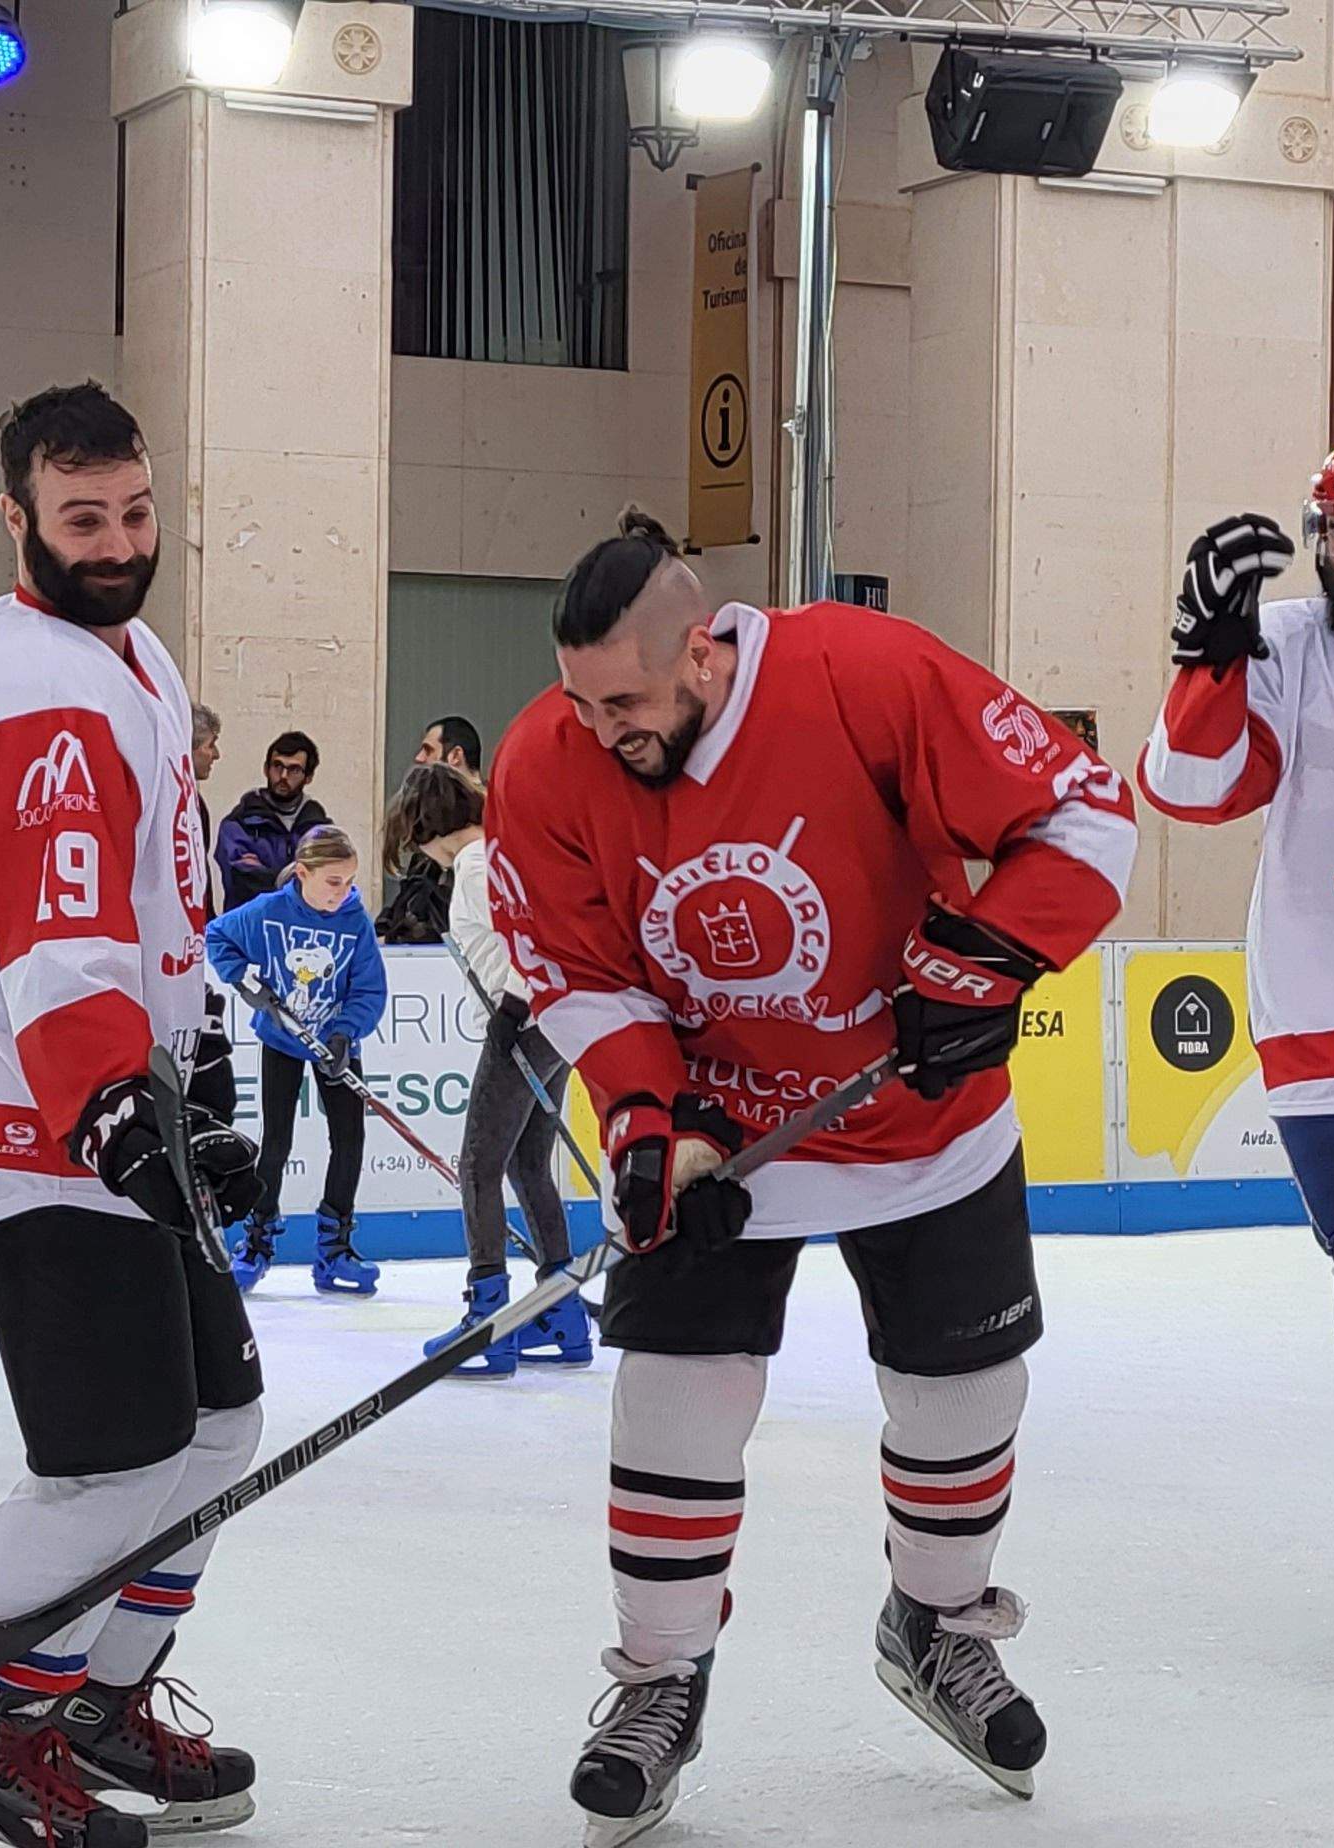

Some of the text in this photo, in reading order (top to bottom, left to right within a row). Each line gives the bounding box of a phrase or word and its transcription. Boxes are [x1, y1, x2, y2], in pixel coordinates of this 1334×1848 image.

[645, 850, 826, 974] CLUB HIELO JACA
[1020, 1010, 1065, 1038] ESA
[1241, 1130, 1277, 1146] Avda.
[370, 1155, 413, 1175] (+34)
[190, 1391, 386, 1542] BAUER
